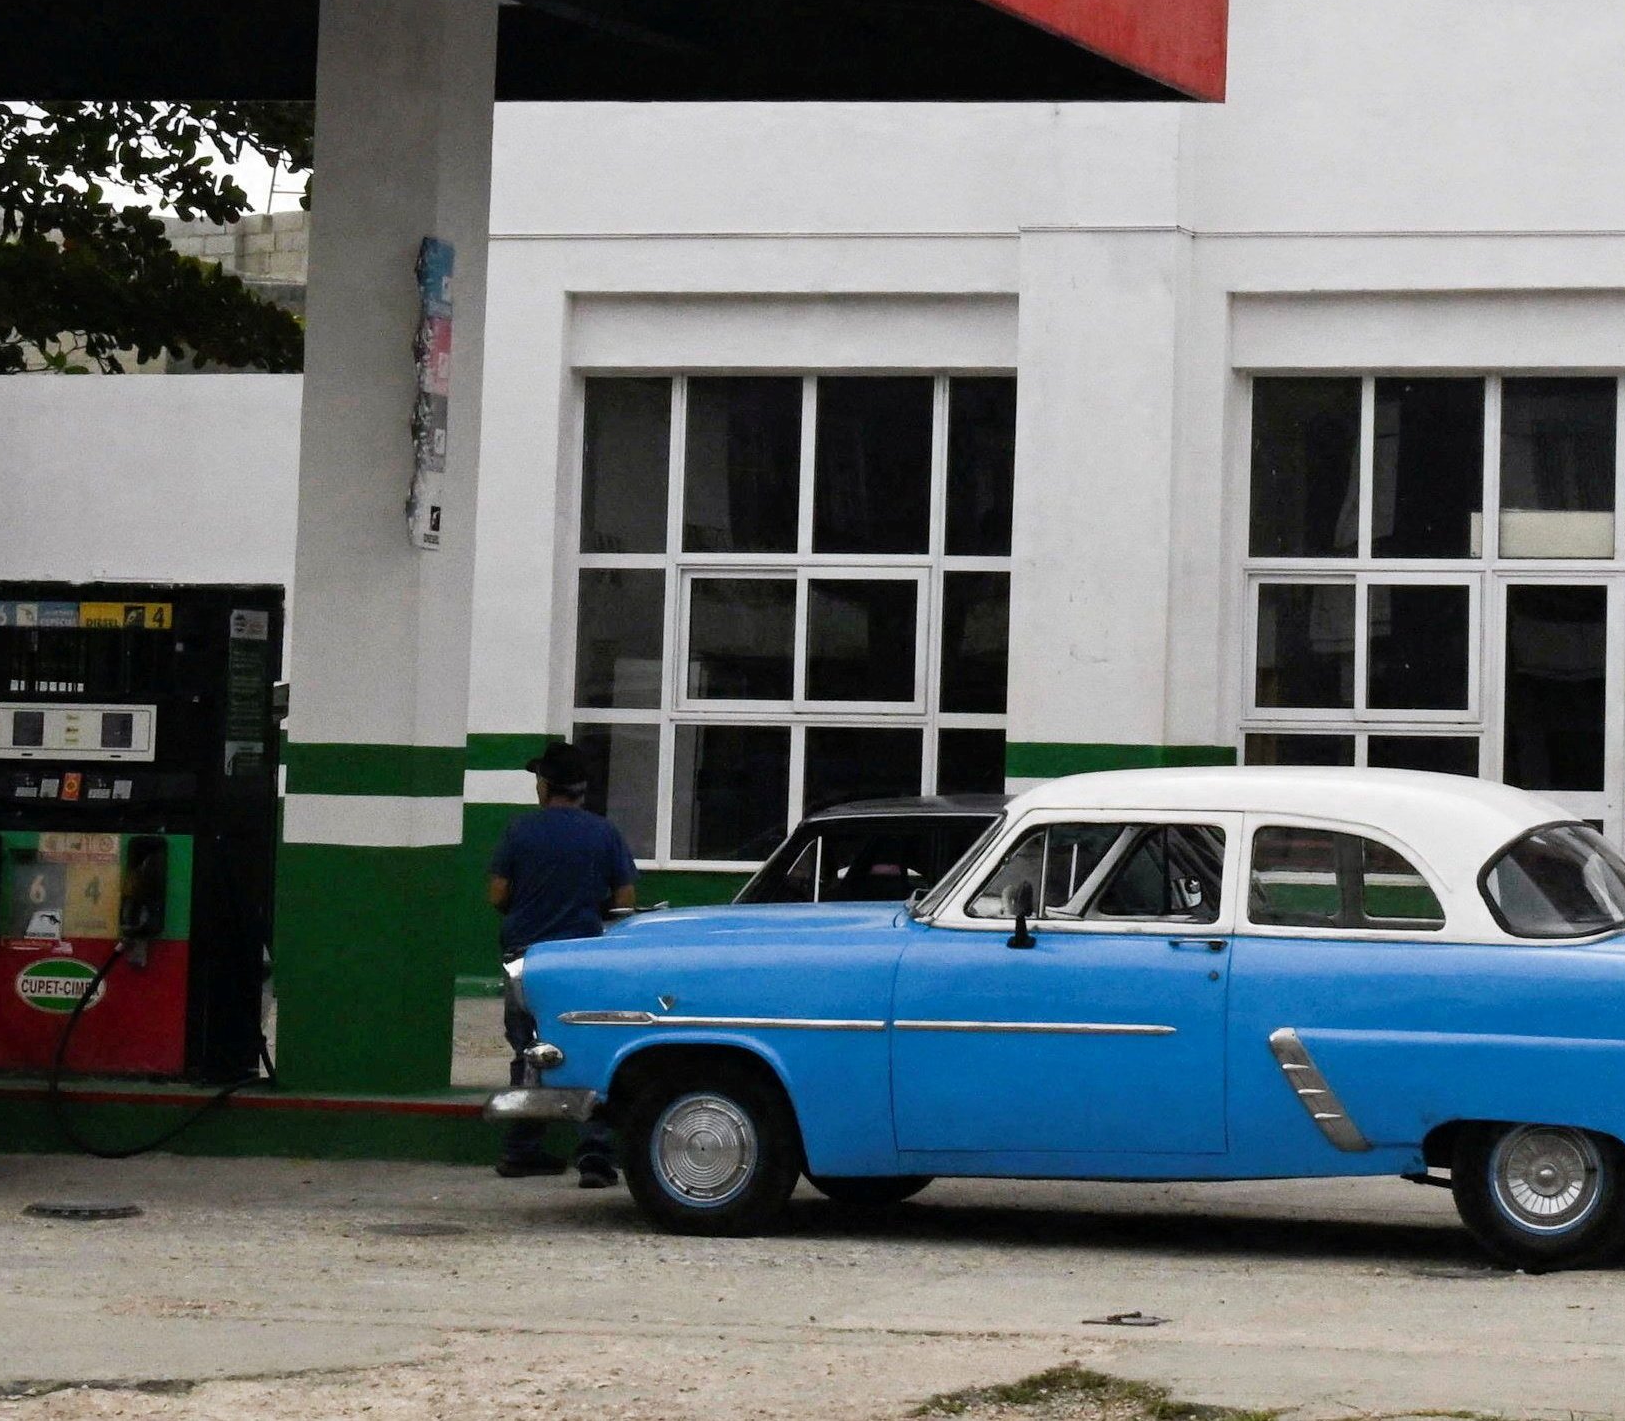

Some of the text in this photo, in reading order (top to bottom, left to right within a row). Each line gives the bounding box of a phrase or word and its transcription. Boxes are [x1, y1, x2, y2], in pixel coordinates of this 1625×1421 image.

[86, 617, 124, 628] DIESEL
[153, 606, 164, 628] 4
[29, 874, 48, 903] 6
[84, 875, 102, 904] 4
[21, 979, 99, 997] CUPET-CIM
